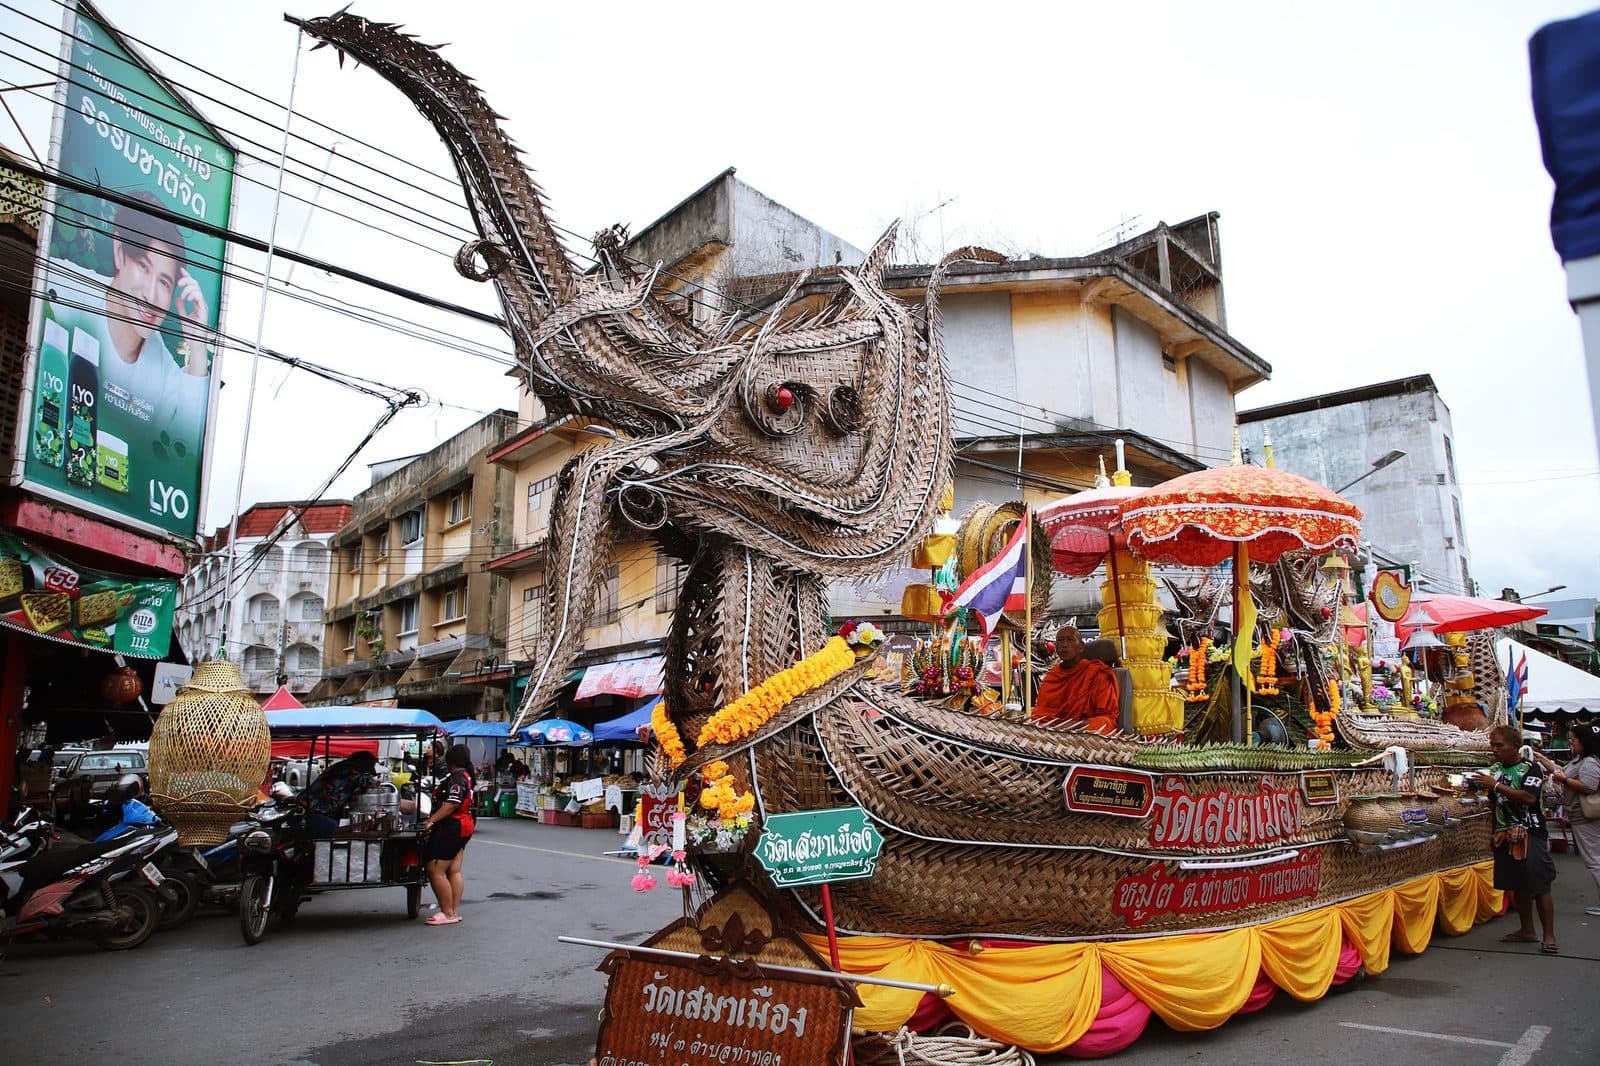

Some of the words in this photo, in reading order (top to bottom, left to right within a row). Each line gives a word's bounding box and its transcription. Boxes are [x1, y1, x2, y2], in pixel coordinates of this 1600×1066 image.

[81, 95, 207, 219] ธรรมชาติจัด
[72, 384, 94, 407] LYO
[149, 479, 189, 519] LYO
[133, 614, 153, 627] PIZZA
[130, 636, 150, 649] 1112
[1150, 774, 1301, 842] วัดเสมาเมือง
[764, 823, 872, 863] วัดเสมาเมือง
[643, 971, 808, 1037] วัดเสมาเมือง
